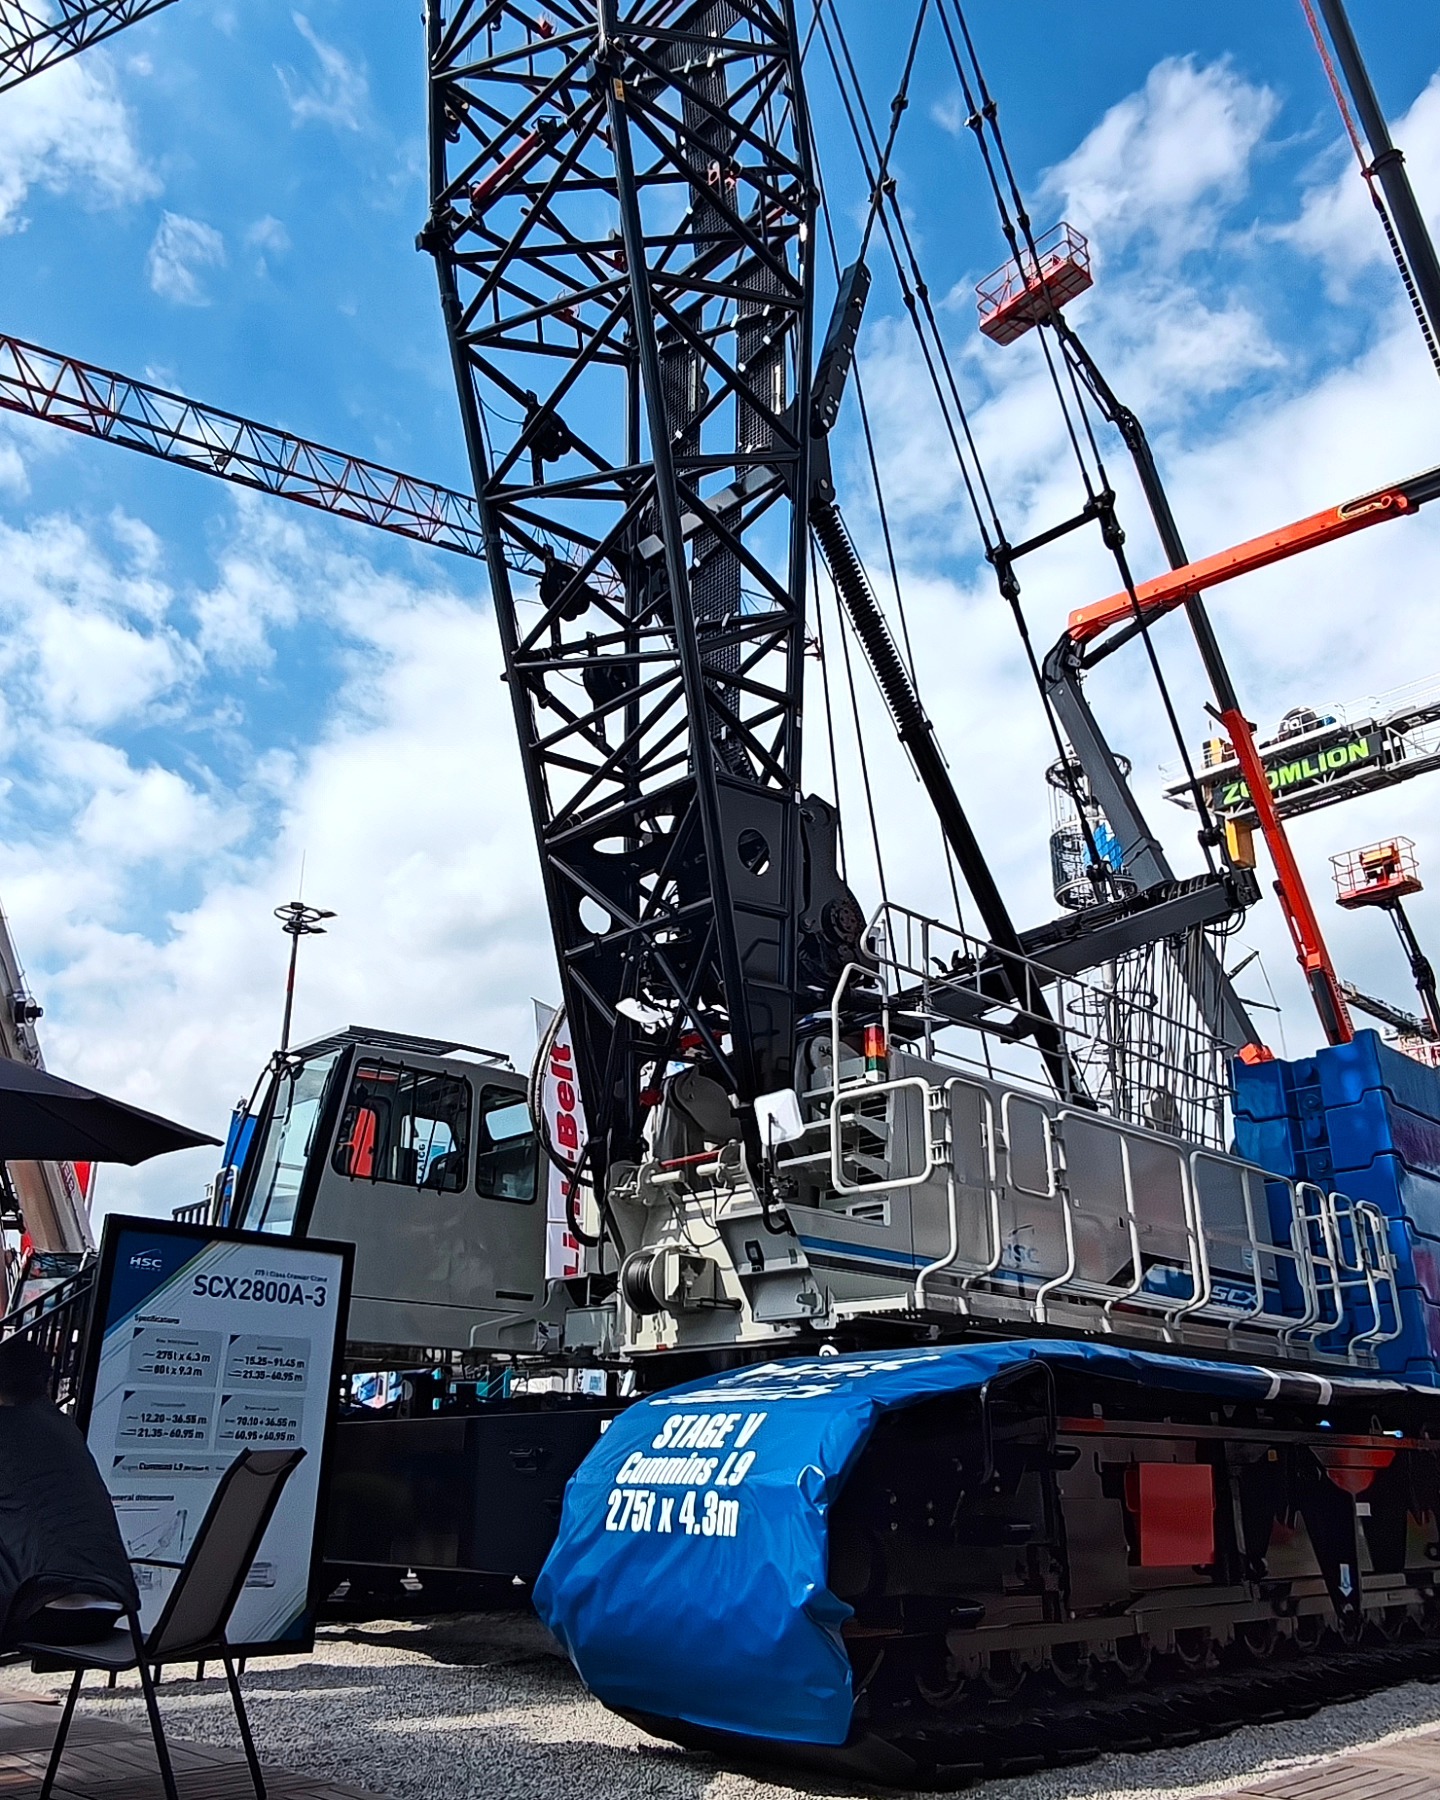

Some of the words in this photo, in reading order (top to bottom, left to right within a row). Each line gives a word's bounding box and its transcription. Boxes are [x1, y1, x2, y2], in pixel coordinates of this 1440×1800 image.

[129, 1256, 162, 1268] HSC
[193, 1274, 327, 1307] SCX2800A-3
[652, 1413, 742, 1449] STAGE
[733, 1412, 768, 1448] V
[615, 1451, 719, 1486] Cummins
[714, 1451, 756, 1487] L9
[605, 1488, 656, 1533] 275t
[657, 1498, 675, 1534] x
[679, 1490, 740, 1538] 4.3m
